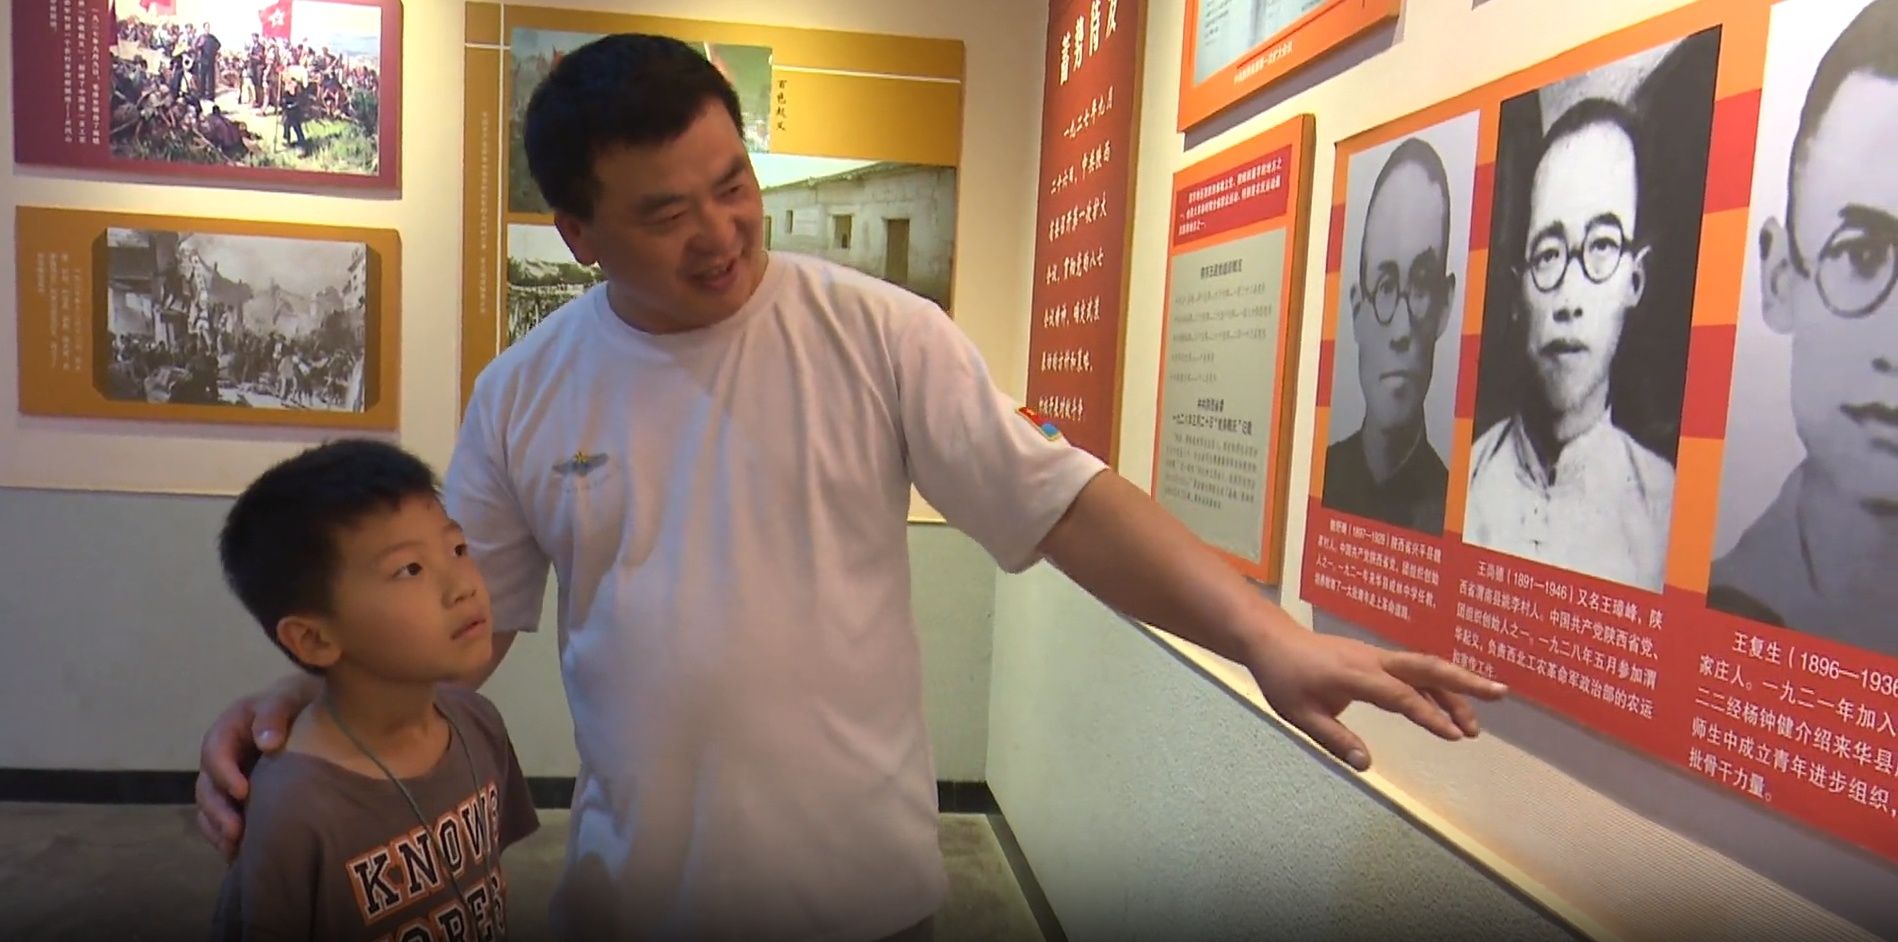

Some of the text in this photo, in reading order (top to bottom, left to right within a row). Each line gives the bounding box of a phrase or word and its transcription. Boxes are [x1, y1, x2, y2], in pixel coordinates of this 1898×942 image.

[776, 79, 788, 131] 百色起义
[1063, 85, 1113, 139] 一九二七年九月
[1454, 626, 1655, 720] 华起义，负责西北工农革命军政治部的农运
[1456, 602, 1657, 690] 团组织创始人之一。一九二八年五月参加渭
[1695, 686, 1898, 781] 二二经杨钟健介绍来华县
[1699, 655, 1896, 738] 家庄人。一九二一年加入
[1688, 747, 1772, 802] 批骨干力量。
[1691, 716, 1897, 818] 师生中成立青年进步组织，
